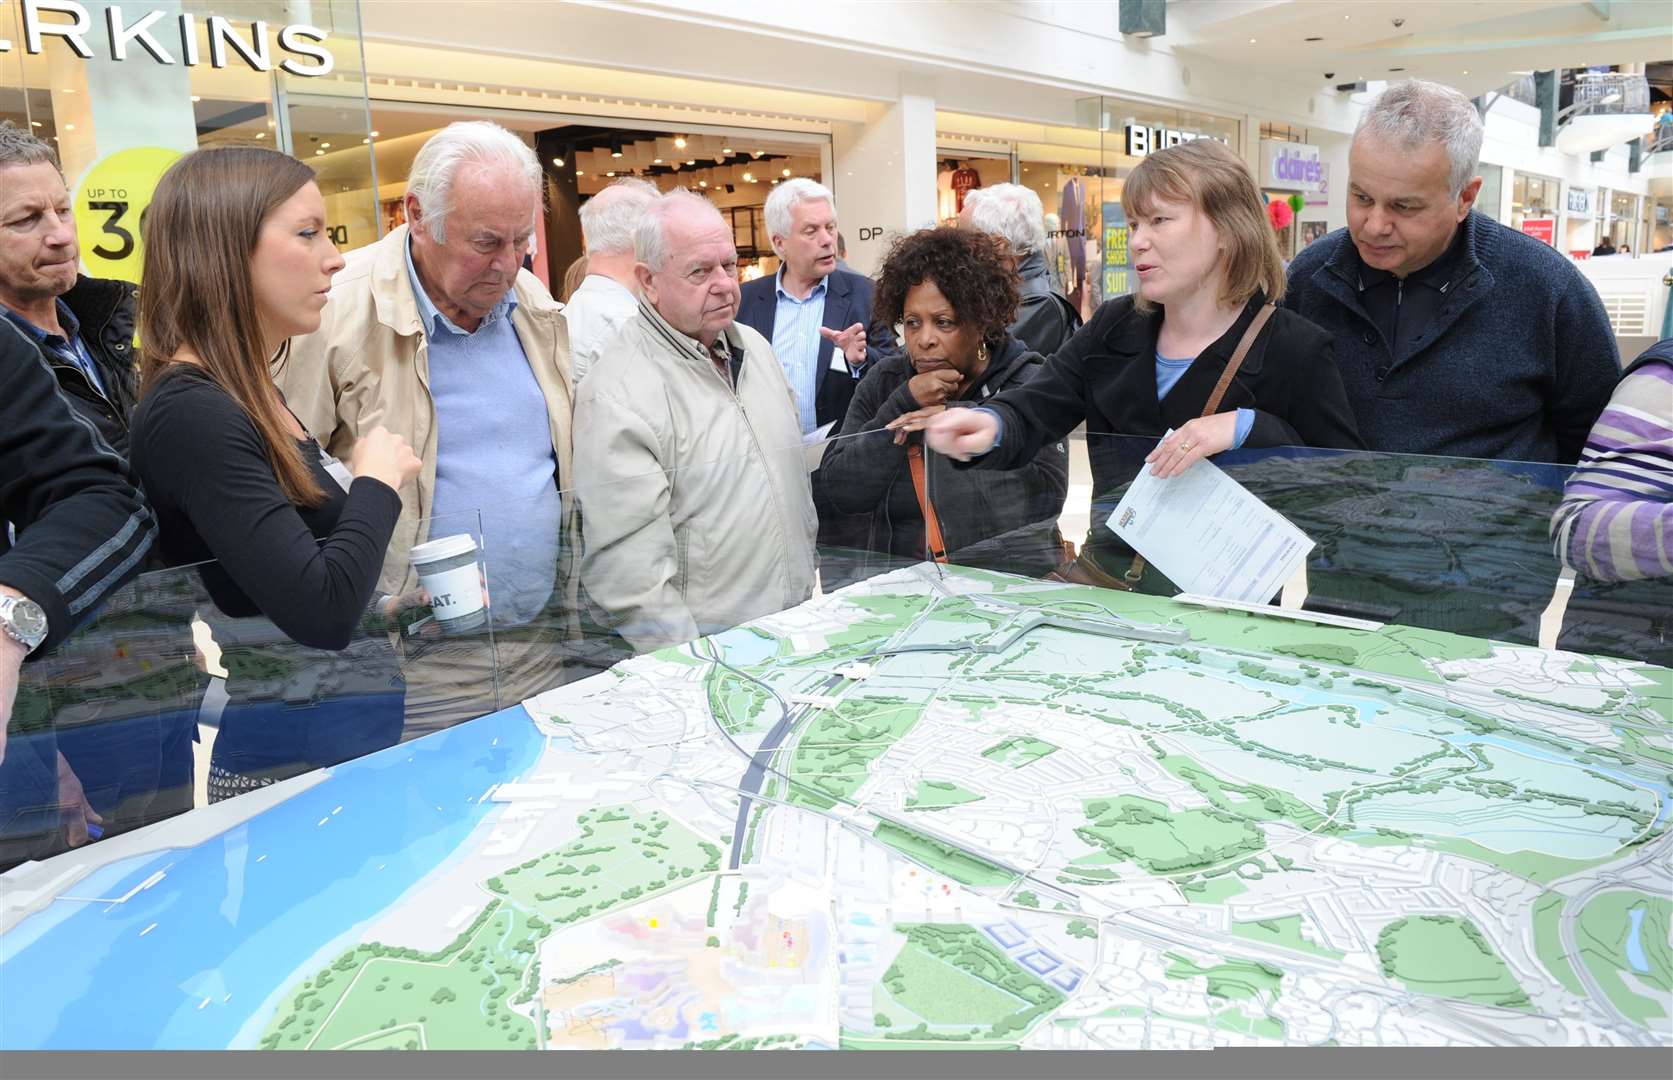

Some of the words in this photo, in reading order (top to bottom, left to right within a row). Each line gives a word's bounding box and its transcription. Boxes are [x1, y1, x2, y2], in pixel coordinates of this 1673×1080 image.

[0, 0, 334, 77] RKINS
[1125, 125, 1228, 157] BUR
[1274, 148, 1323, 182] claire's
[88, 188, 105, 198] UP
[109, 188, 127, 199] TO
[88, 201, 149, 260] 3
[859, 226, 884, 241] DP
[1106, 228, 1127, 248] FREE
[1106, 249, 1127, 265] SHOES
[1106, 271, 1127, 293] SUIT
[429, 593, 456, 608] AT.
